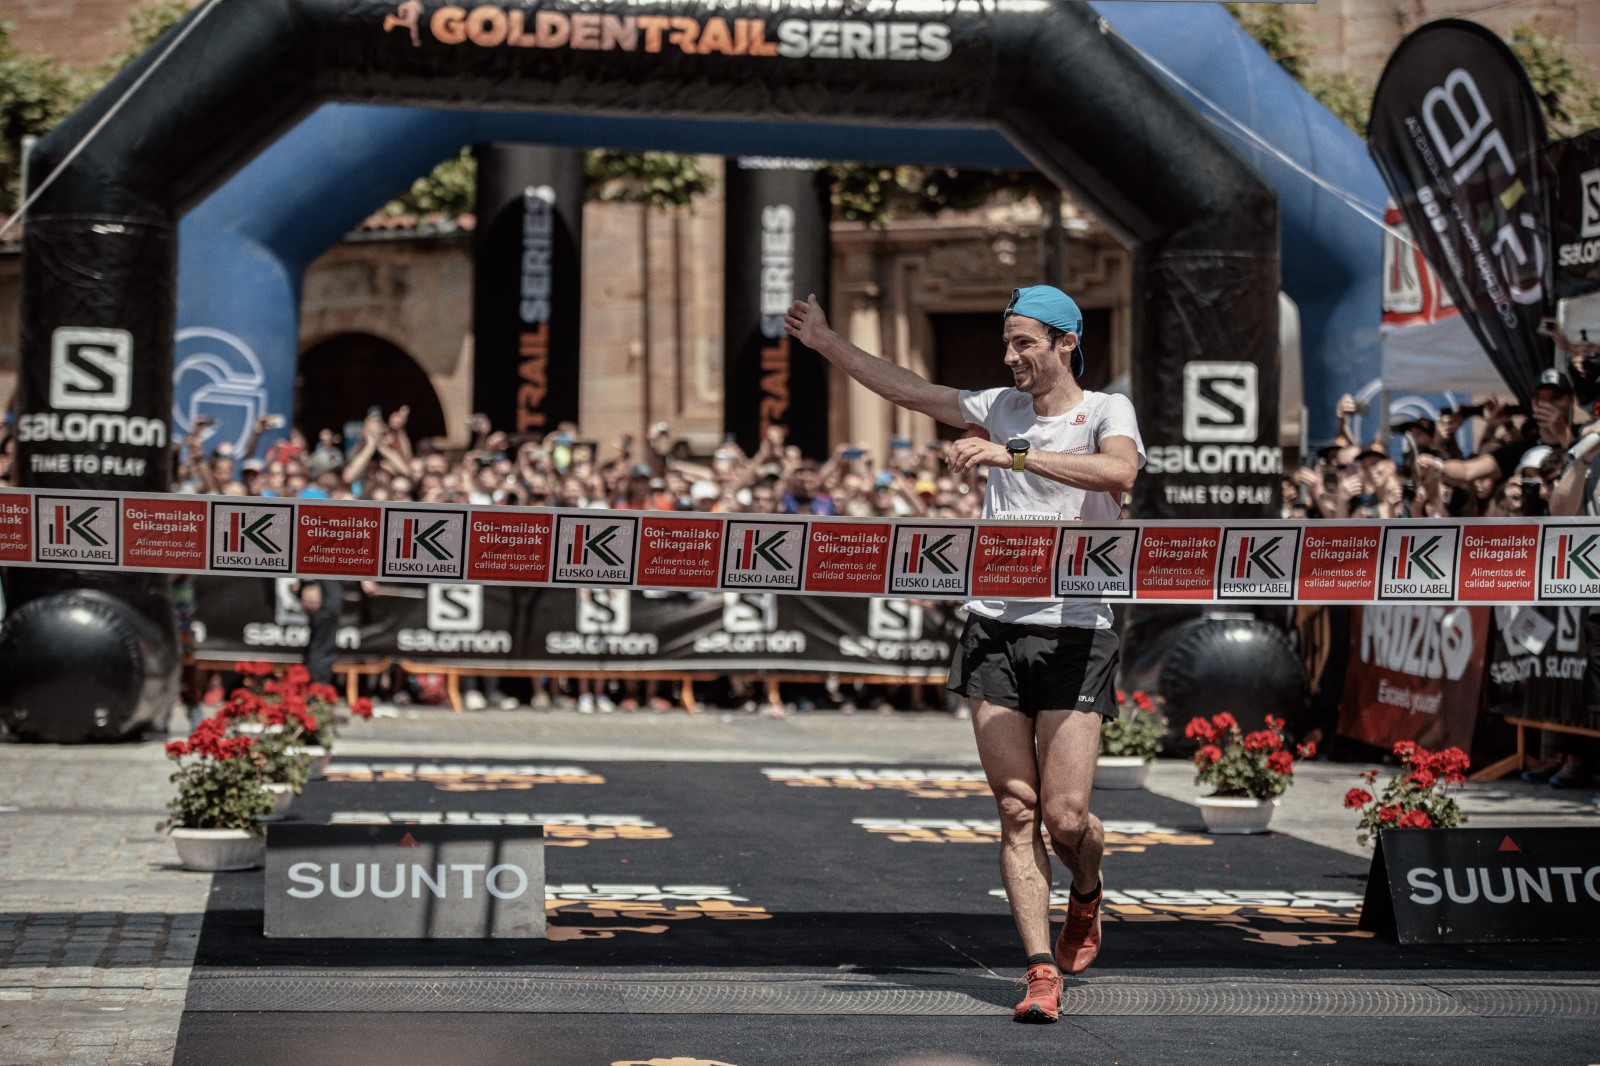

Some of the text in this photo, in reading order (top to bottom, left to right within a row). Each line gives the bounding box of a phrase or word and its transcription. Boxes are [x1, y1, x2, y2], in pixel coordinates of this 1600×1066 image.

[30, 453, 147, 477] TIME TO PLAY
[1164, 486, 1273, 504] TIME TO PLAY
[127, 509, 204, 521] Goi-mailako
[301, 516, 377, 528] Goi-mailako
[133, 522, 196, 533] elikagaiak
[473, 522, 549, 534] Goi-mailako
[10, 532, 22, 540] de
[307, 528, 370, 540] elikagaiak
[644, 528, 719, 539] Goi-mailako
[813, 532, 887, 544] Goi-mailako
[136, 538, 196, 548] Alimentos de
[480, 535, 542, 546] elikagaiak
[980, 536, 1052, 547] Goi-mailako
[1144, 538, 1216, 547] Goi-mailako
[1306, 537, 1376, 547] Goi-mailako
[1465, 536, 1535, 547] Goi-mailako
[310, 545, 368, 555] Alimentos de
[650, 540, 712, 552] elikagaiak
[818, 544, 880, 556] elikagaiak
[42, 548, 113, 559] EUSKO LABEL
[165, 550, 201, 558] superior
[482, 552, 539, 561] Alimentos de
[985, 548, 1045, 557] elikagaiak
[1149, 549, 1208, 560] elikagaiak
[1311, 549, 1368, 562] elikagaiak
[1470, 548, 1528, 562] elikagaiak
[216, 556, 286, 567] EUSKO LABEL
[338, 557, 374, 566] superior
[651, 557, 709, 566] Alimentos de
[819, 562, 876, 570] Alimentos de
[388, 563, 458, 573] EUSKO LABEL
[510, 563, 545, 572] superior
[679, 568, 714, 576] superior
[985, 564, 1028, 572] Alimentos
[1149, 567, 1192, 575] Alimentos
[1311, 568, 1366, 577] Alimentos de
[1471, 568, 1513, 577] Alimentos
[559, 569, 628, 579] EUSKO LABEL
[728, 574, 796, 584] EUSKO LABEL
[846, 573, 882, 581] superior
[895, 578, 963, 588] EUSKO LABEL
[979, 575, 1047, 585] calidad superior
[1143, 578, 1210, 587] calidad superior
[1305, 579, 1371, 589] calidad superior
[1465, 579, 1531, 589] calidad superior
[1061, 581, 1128, 591] EUSKO LABEL
[1223, 583, 1289, 593] EUSKO LABEL
[1384, 584, 1449, 594] EUSKO LABEL
[1544, 584, 1600, 594] EUSKO LAB
[286, 862, 528, 900] SUUNTO
